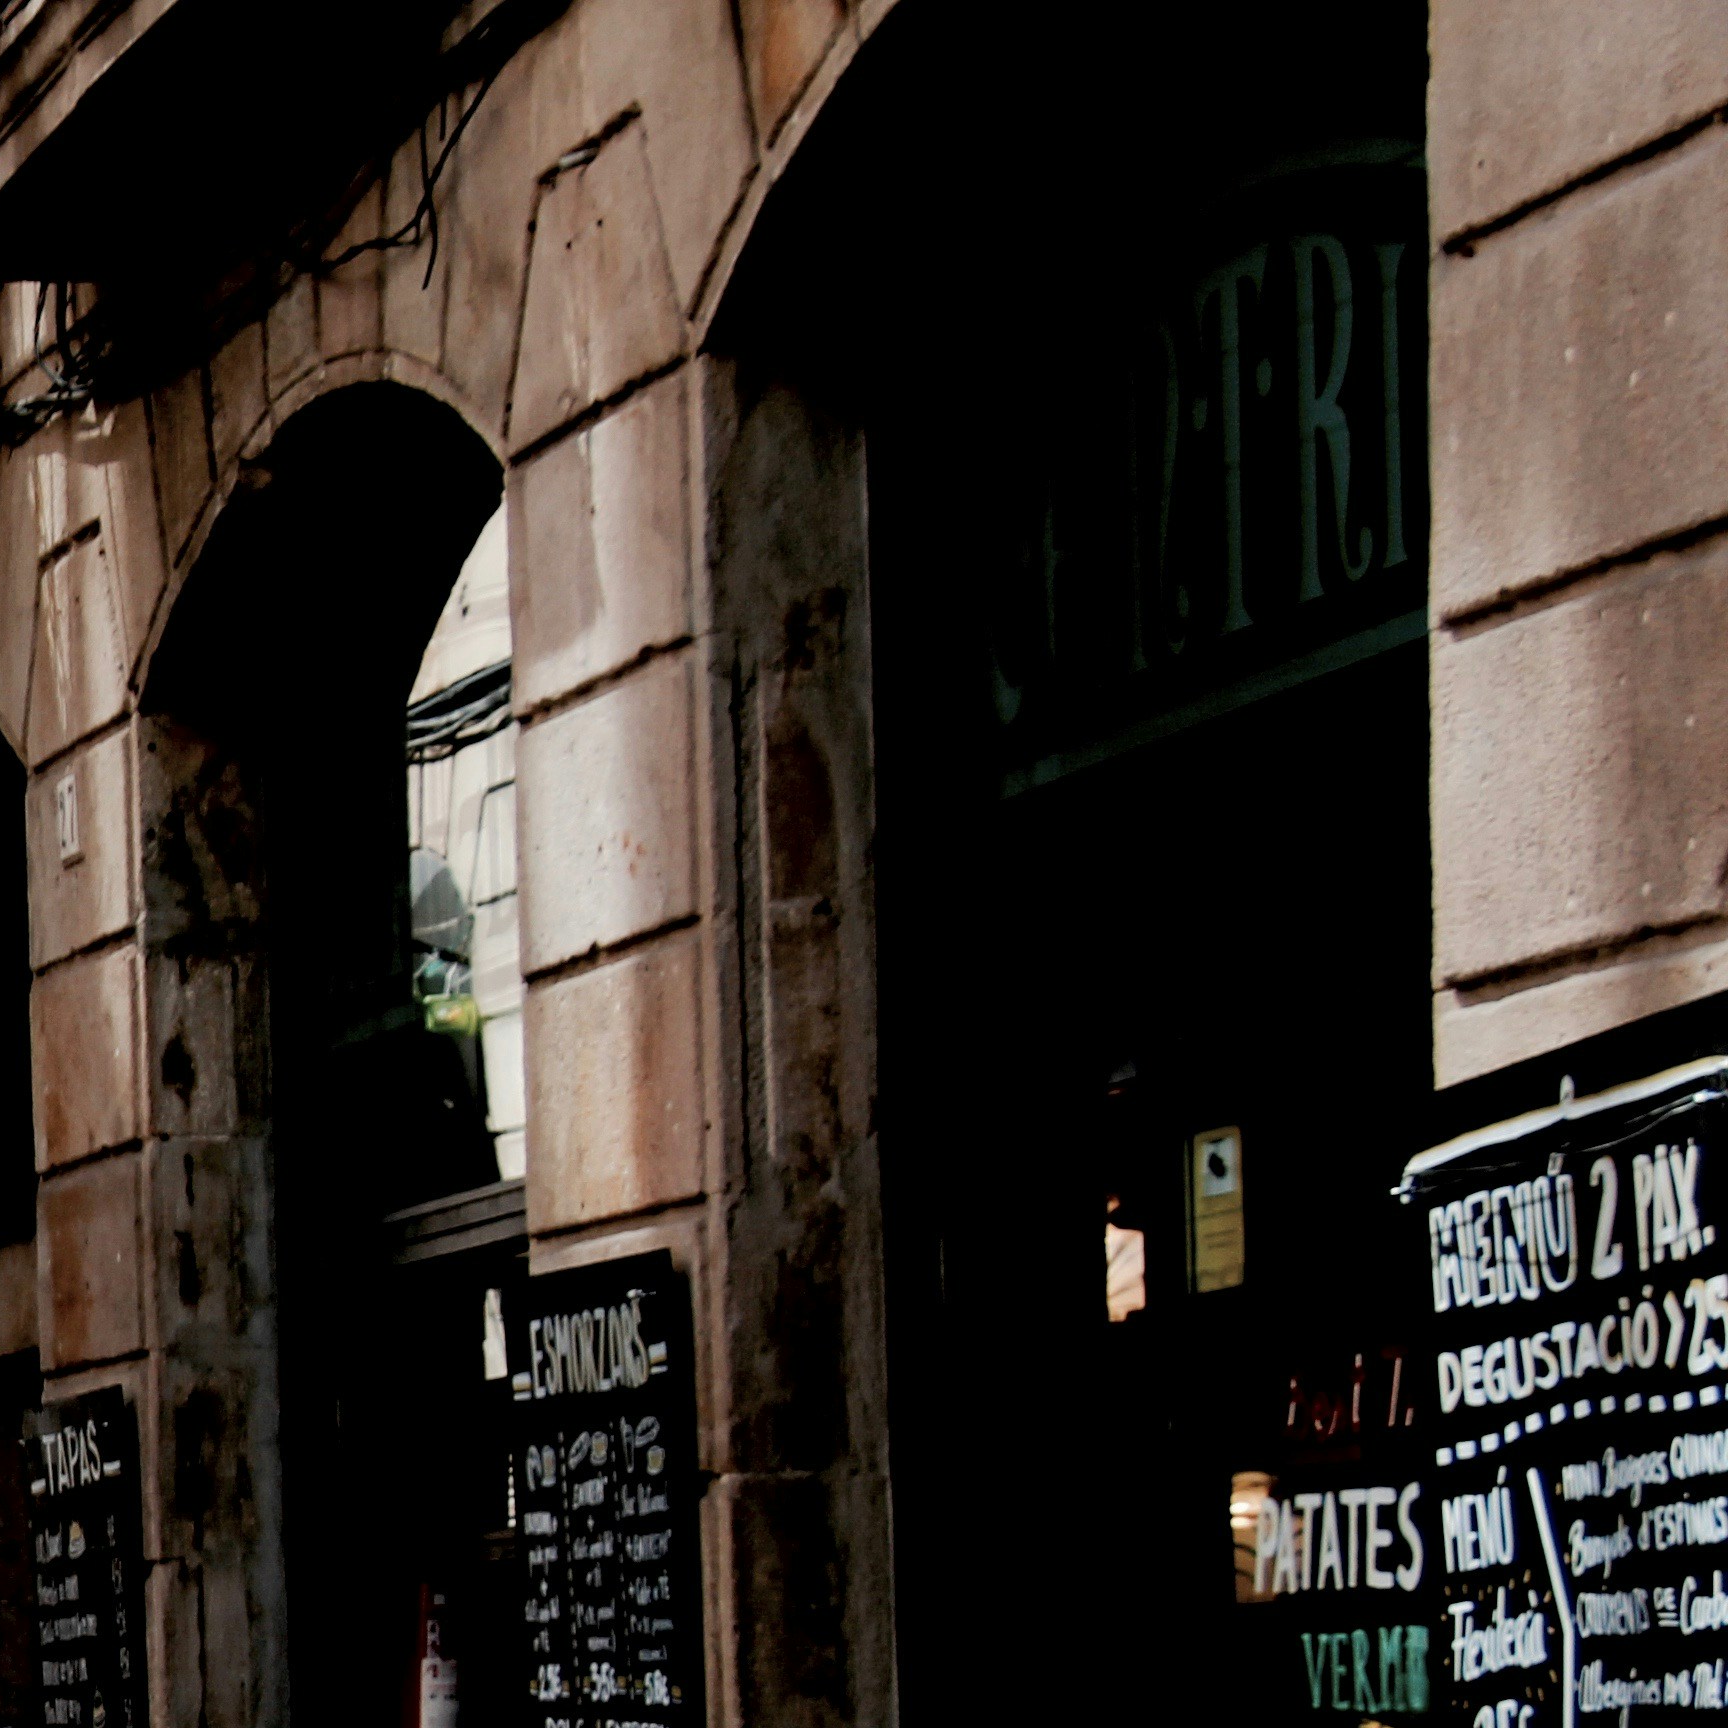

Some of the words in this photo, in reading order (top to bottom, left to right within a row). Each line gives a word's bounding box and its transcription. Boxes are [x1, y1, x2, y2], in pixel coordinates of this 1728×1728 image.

[1430, 1153, 1578, 1312] MENÚ
[1590, 1155, 1624, 1280] 2
[42, 1419, 100, 1496] TAPAS
[1254, 1481, 1424, 1592] PATATES
[1442, 1466, 1515, 1574] MENÚ
